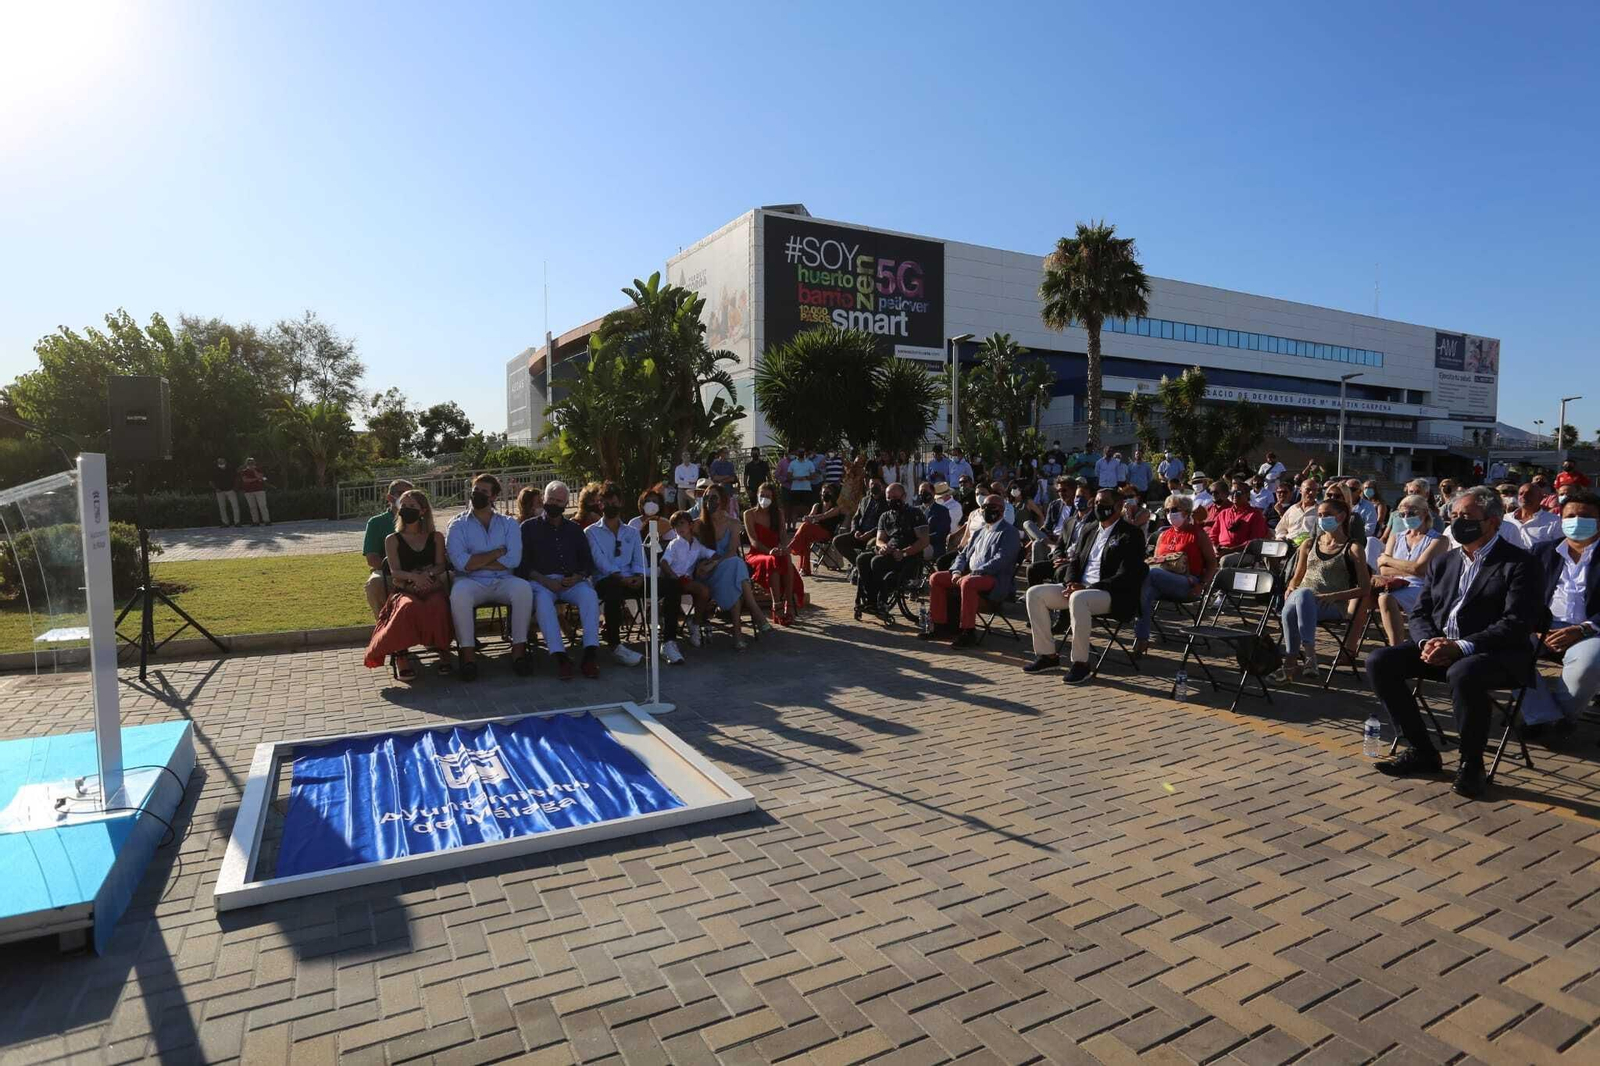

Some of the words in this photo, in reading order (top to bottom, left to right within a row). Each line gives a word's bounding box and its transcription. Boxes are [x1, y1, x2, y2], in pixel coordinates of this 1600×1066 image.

[785, 235, 859, 271] #SOY
[798, 264, 853, 288] huerto
[856, 255, 875, 311] zen
[876, 259, 924, 298] 5G
[798, 283, 853, 307] barrio
[800, 305, 828, 314] 10.000
[801, 314, 831, 324] PASOS
[832, 309, 908, 336] smart
[1252, 392, 1294, 404] DEPORTES
[1331, 400, 1359, 409] MATIN
[1361, 402, 1392, 411] CARPENA
[380, 781, 591, 824] Ayuntamiento
[413, 817, 455, 835] de
[465, 796, 577, 826] Málaga
